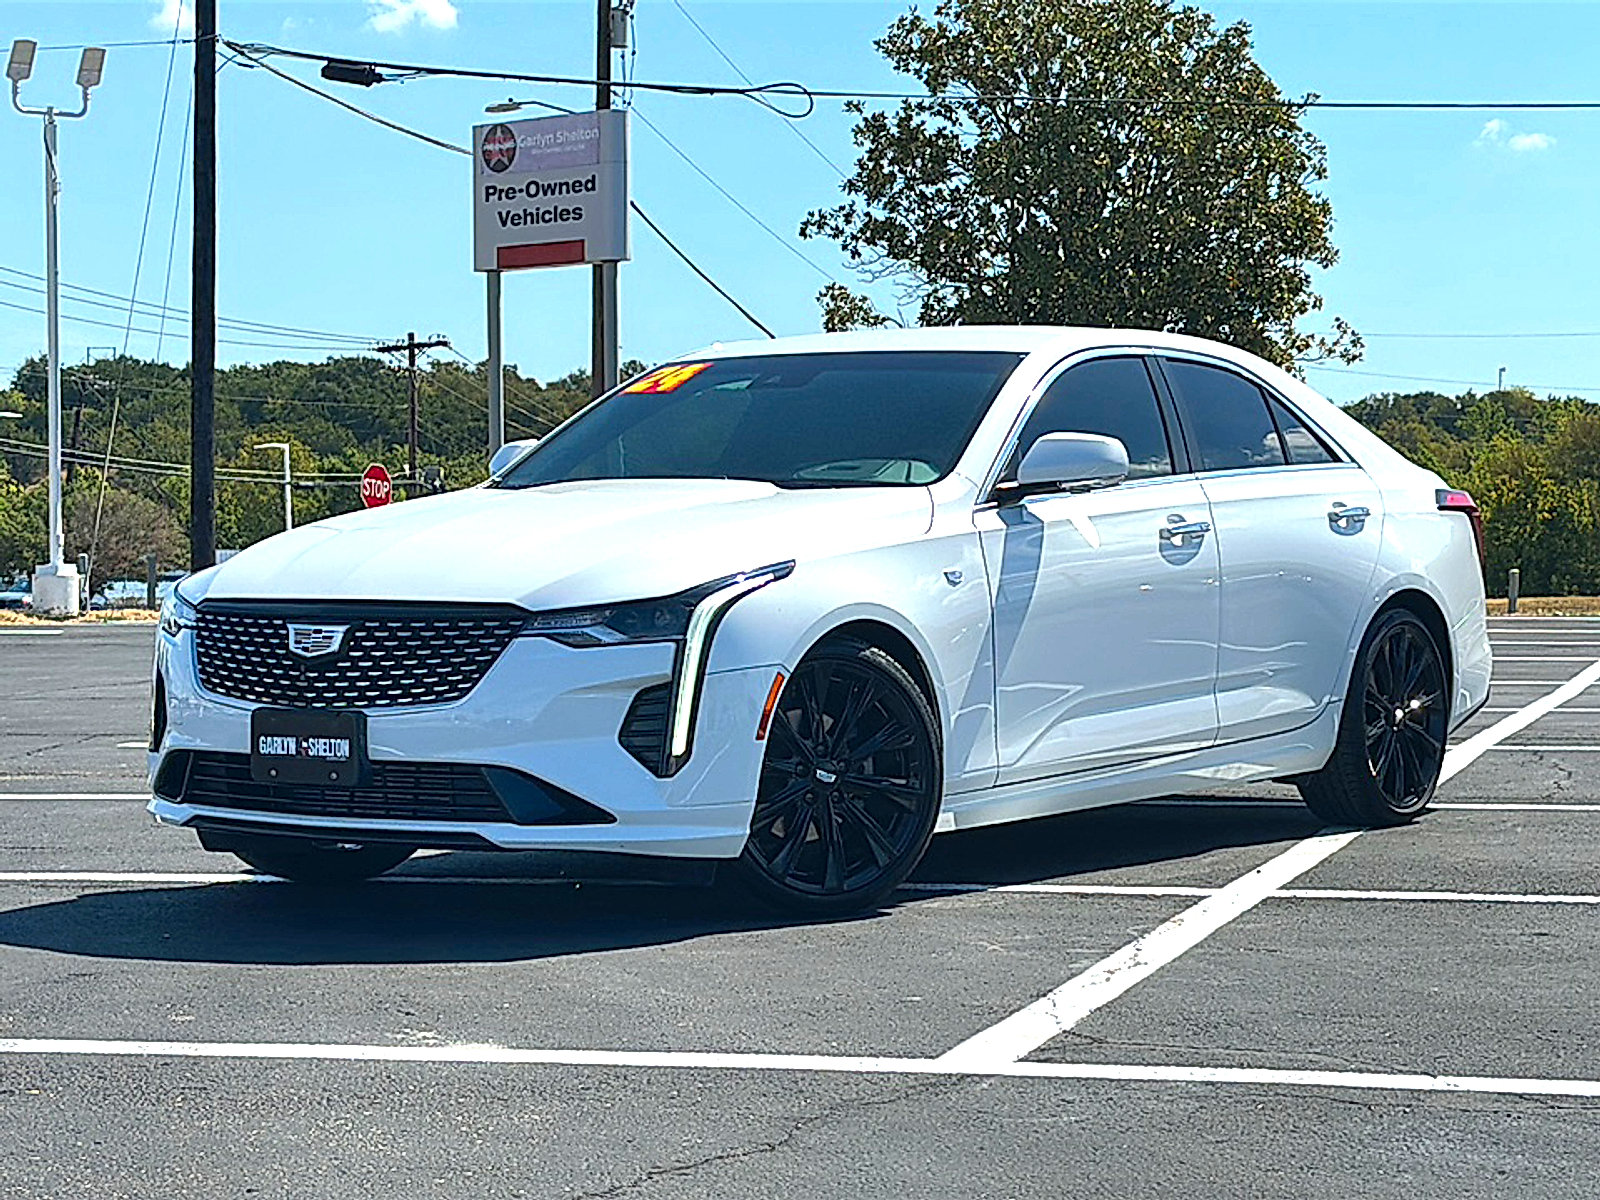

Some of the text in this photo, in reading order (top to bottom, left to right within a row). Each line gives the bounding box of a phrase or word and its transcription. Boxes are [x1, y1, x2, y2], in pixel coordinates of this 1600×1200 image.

[519, 134, 555, 149] Garlyn
[556, 127, 600, 143] Shelton
[484, 174, 597, 203] Pre-Owned
[497, 205, 584, 228] Vehicles
[363, 477, 390, 500] STOP
[308, 737, 350, 758] SHELTON
